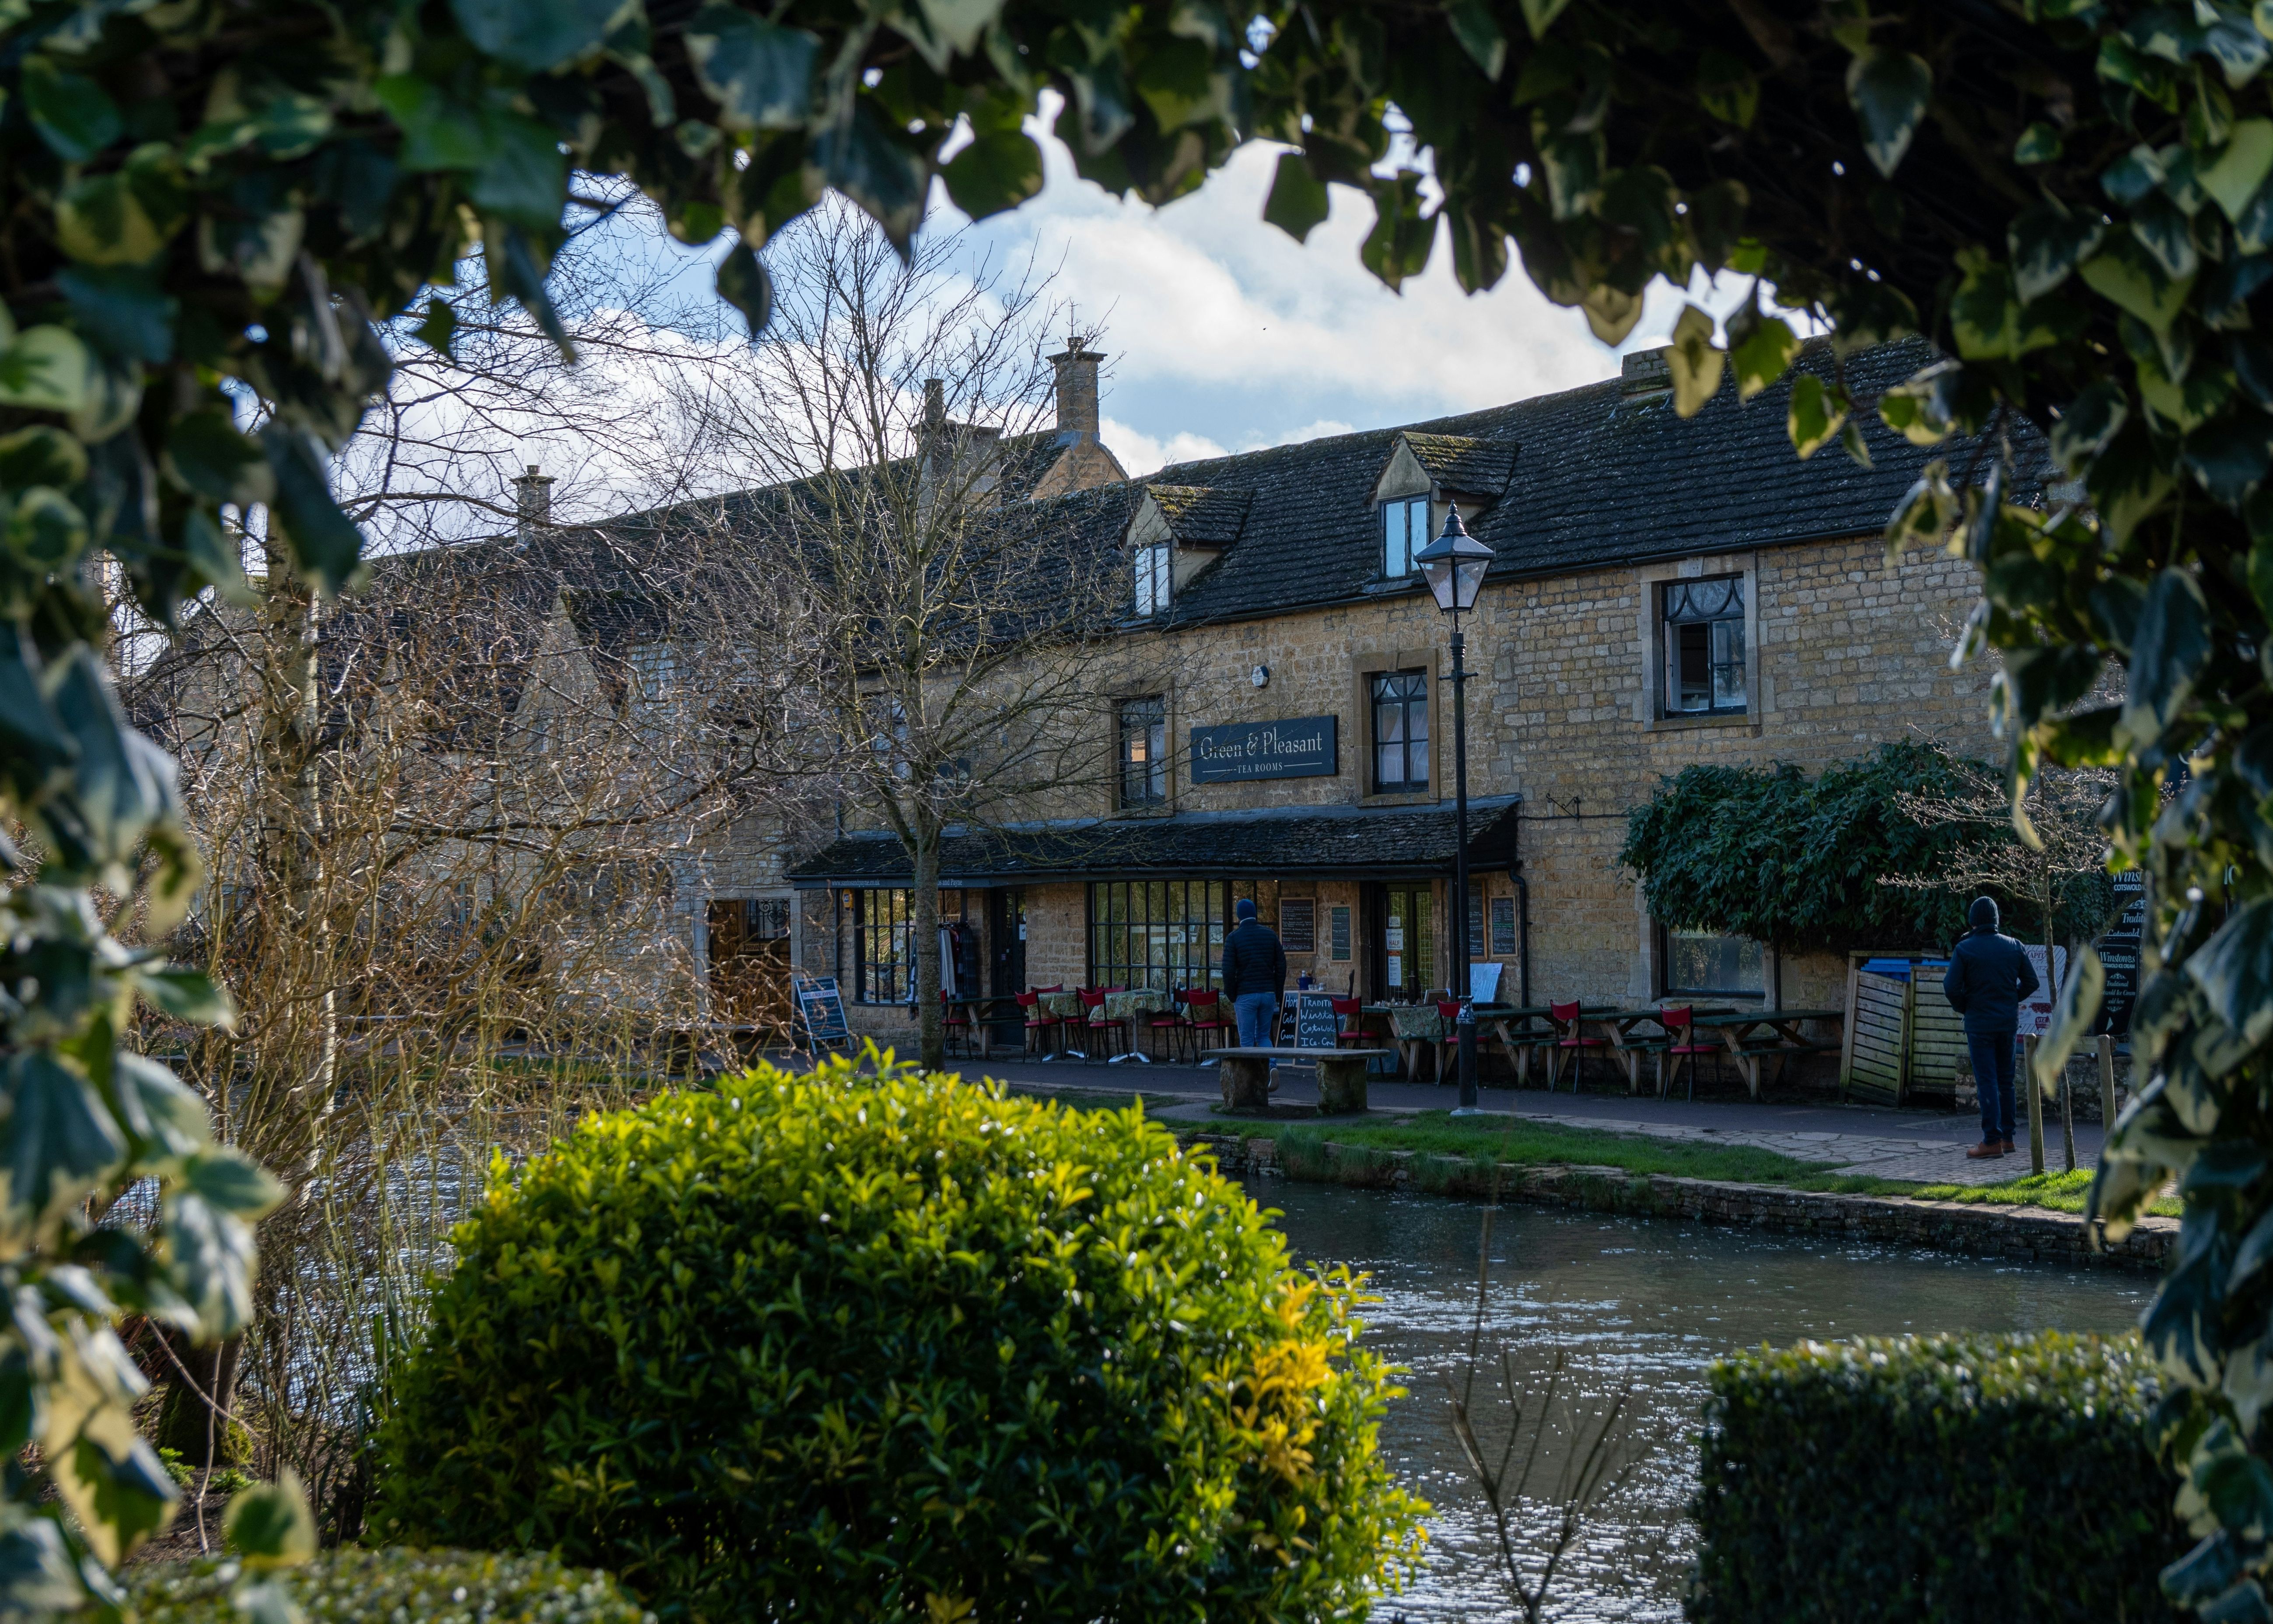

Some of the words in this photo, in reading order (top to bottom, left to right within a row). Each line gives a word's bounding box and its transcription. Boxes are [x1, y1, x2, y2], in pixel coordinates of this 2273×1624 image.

[1200, 735, 1242, 760] Green
[1246, 733, 1259, 756] &
[1262, 726, 1322, 755] Pleasant
[1238, 764, 1252, 774] TEA
[1255, 762, 1283, 772] ROOMS
[951, 878, 962, 887] Payne
[2100, 952, 2135, 963] Winstones
[1285, 995, 1298, 1008] HOM
[1301, 996, 1332, 1008] TRADITI
[1283, 1012, 1296, 1024] Cots
